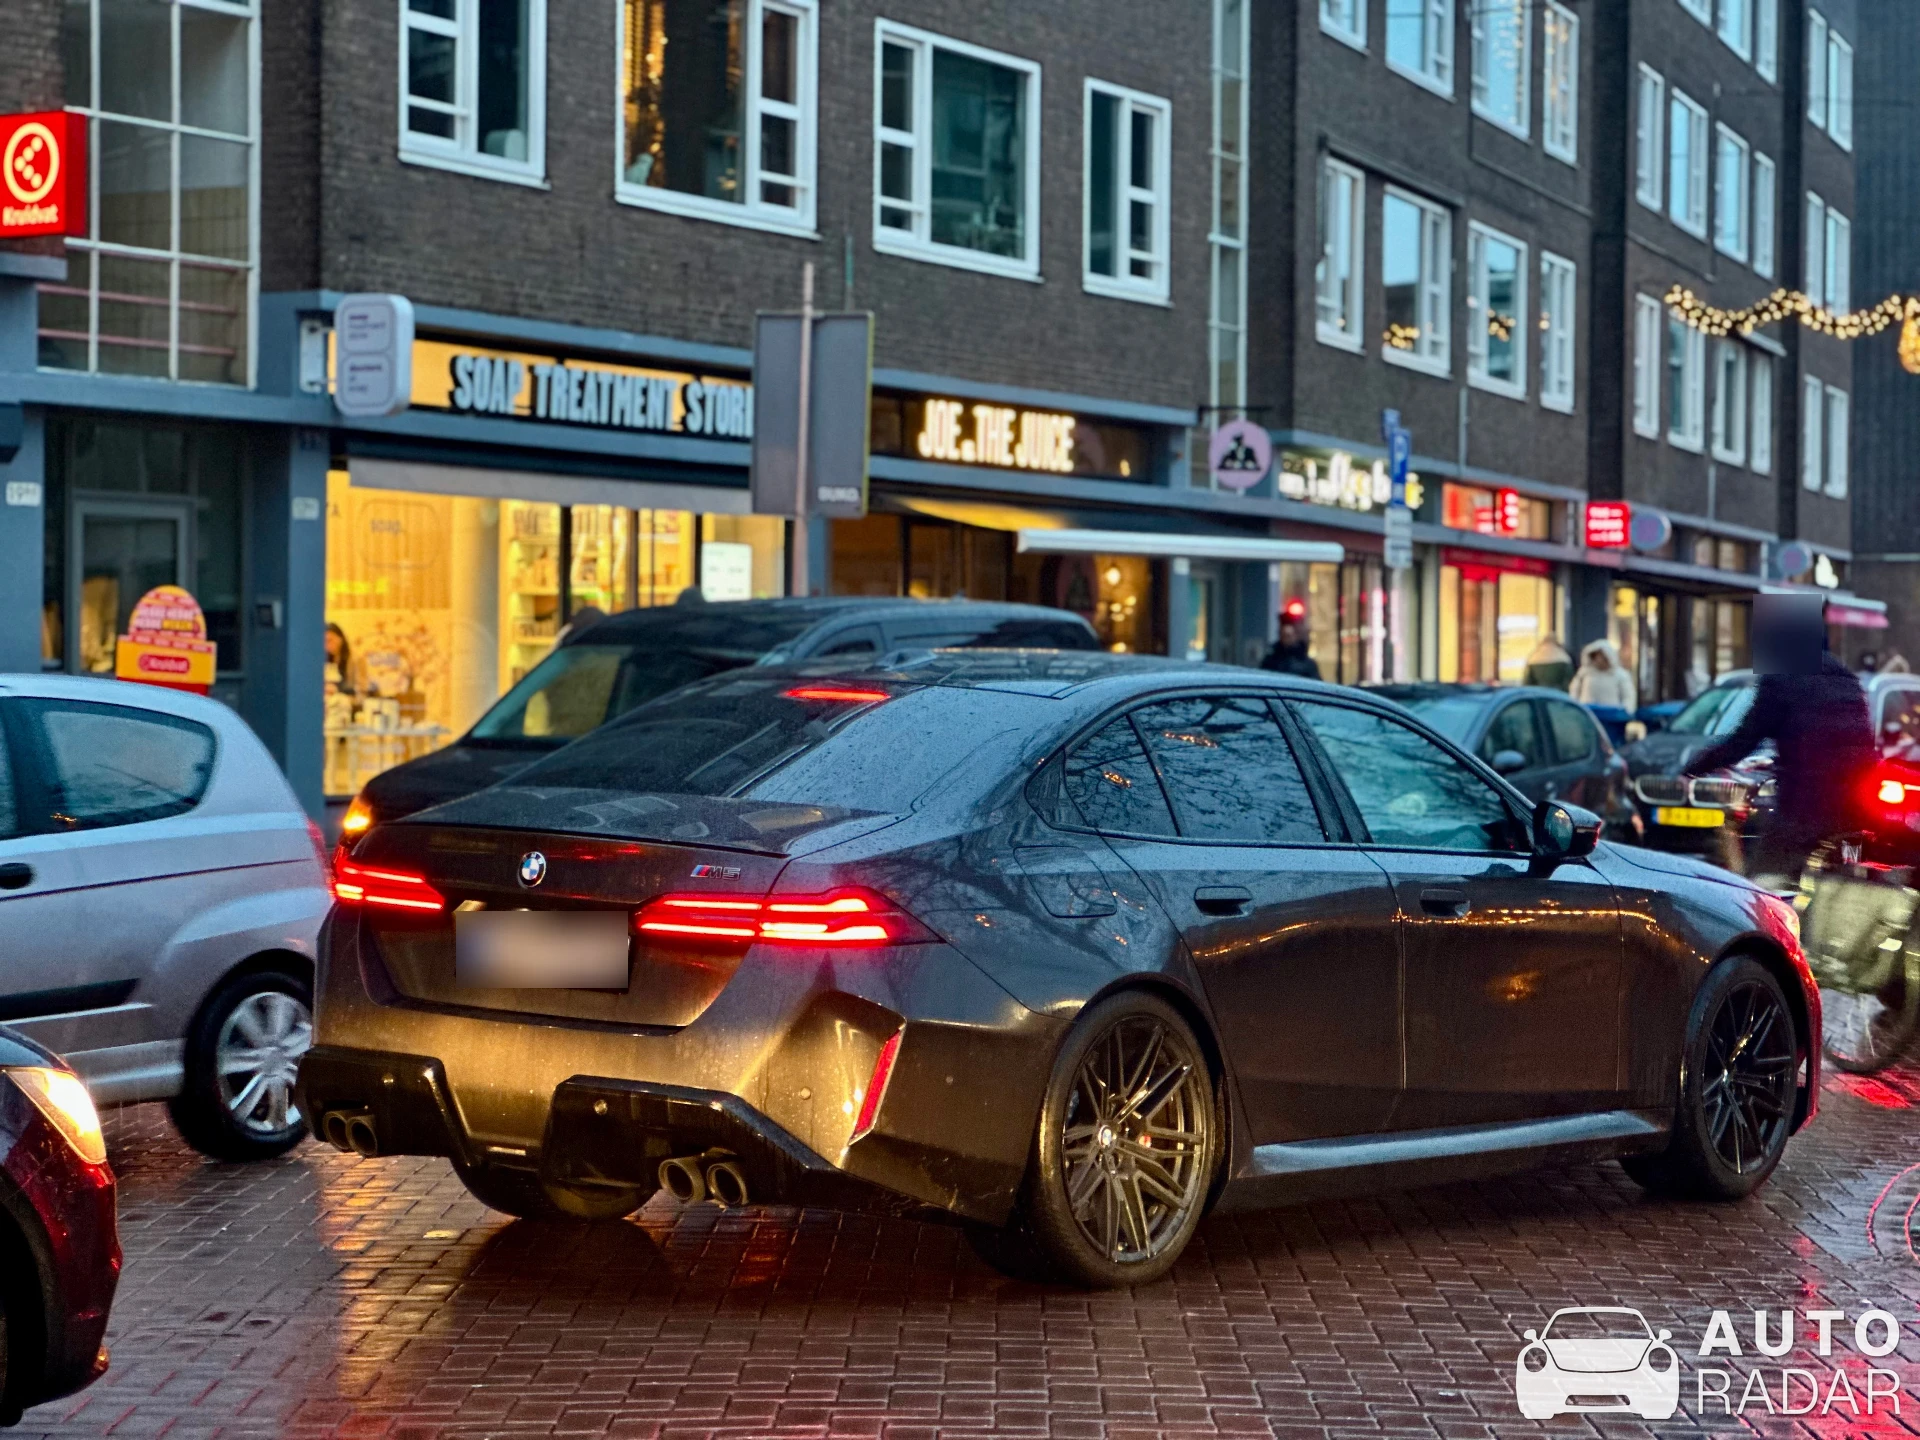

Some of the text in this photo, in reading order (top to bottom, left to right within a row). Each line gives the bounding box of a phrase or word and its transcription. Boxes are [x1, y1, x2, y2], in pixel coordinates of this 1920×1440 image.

[2, 204, 58, 226] Kruidvat
[454, 354, 523, 415] SOAP
[534, 363, 677, 432] TREATMENT
[917, 399, 964, 461] JOE
[972, 404, 1017, 467] THE
[1014, 411, 1076, 473] JUICE
[703, 865, 741, 880] M5
